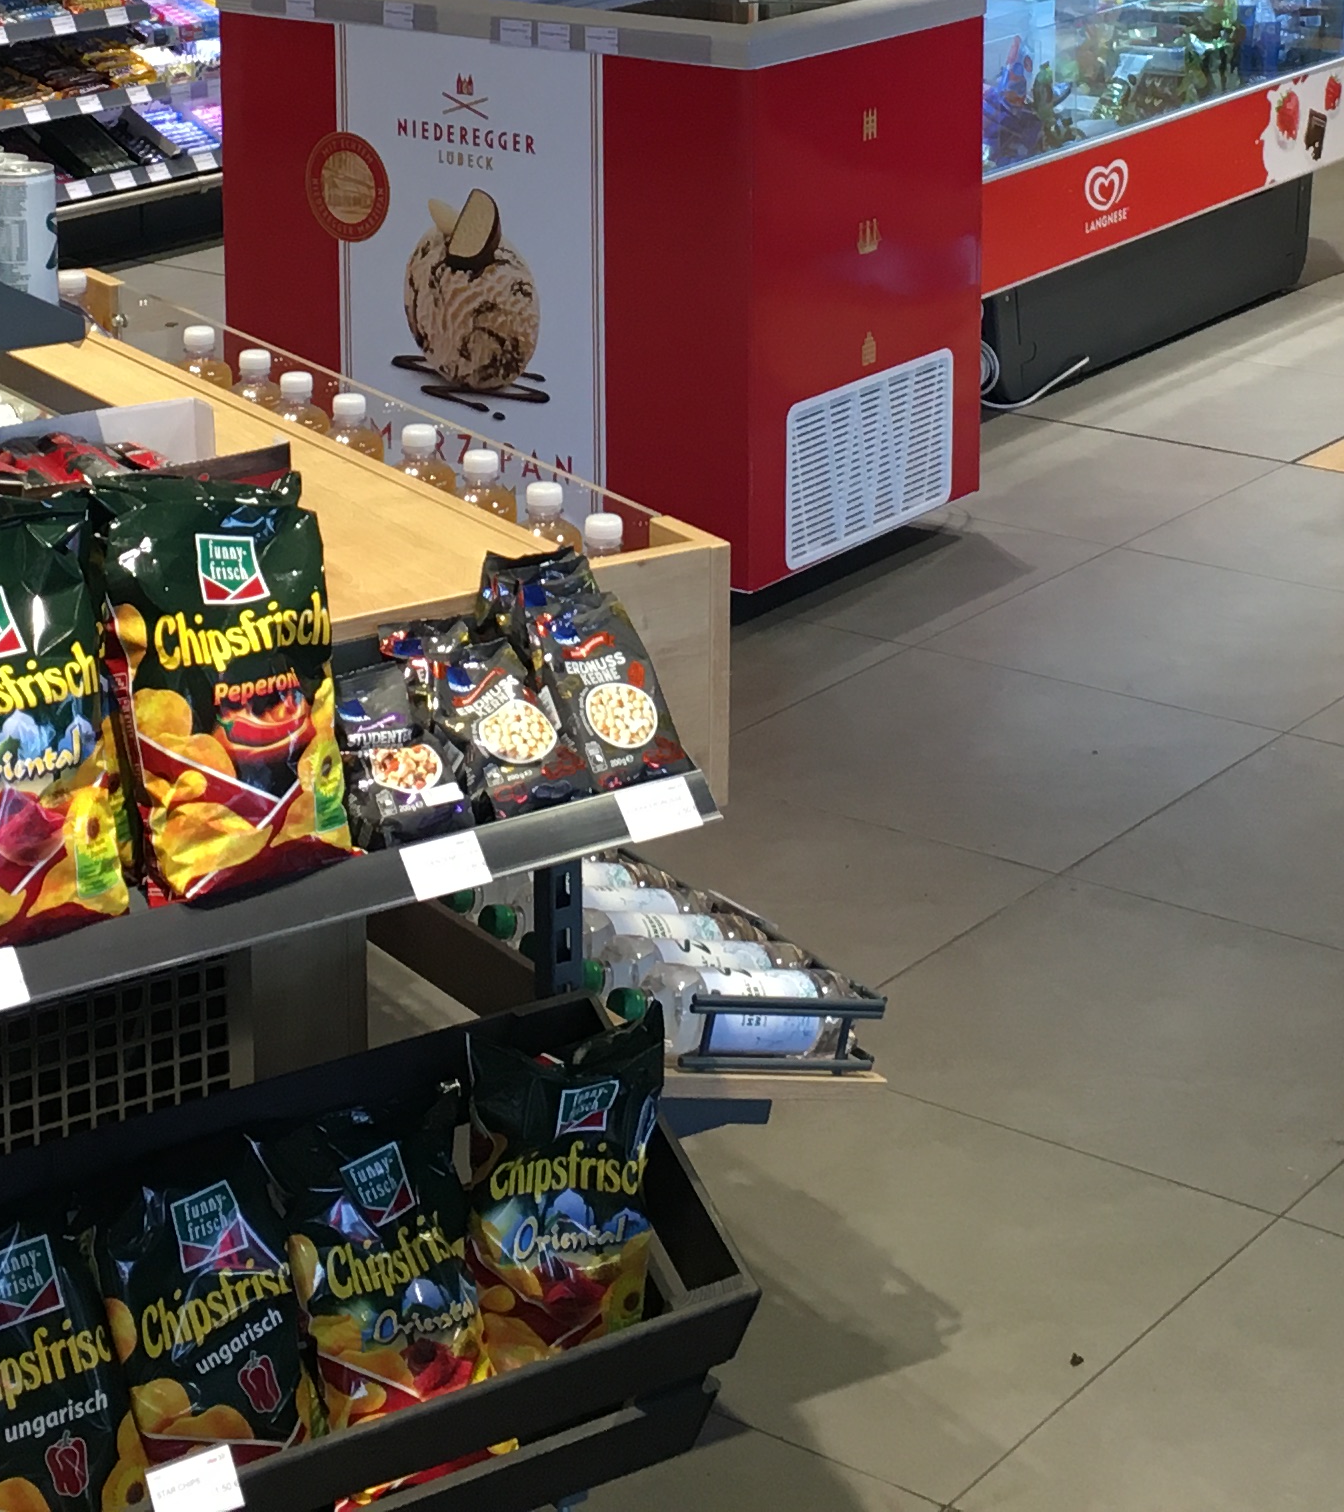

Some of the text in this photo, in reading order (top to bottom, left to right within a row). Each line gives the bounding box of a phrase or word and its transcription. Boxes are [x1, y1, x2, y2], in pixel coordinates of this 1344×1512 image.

[396, 118, 537, 155] NIEDEREGGER
[438, 149, 494, 171] LÜBECK
[1084, 207, 1128, 234] LANGNESE
[369, 418, 574, 486] MRZIPAN
[209, 544, 248, 563] funny-
[209, 561, 249, 580] frisch
[154, 592, 331, 673] Chipsfrisch
[564, 652, 626, 676] ERDNUSS
[213, 669, 301, 705] Peperoni
[349, 1156, 394, 1182] funny-
[183, 1192, 228, 1218] funny-
[356, 1177, 398, 1205] frisch
[187, 1212, 229, 1238] frisch
[513, 1215, 629, 1263] Oriental
[326, 1210, 461, 1299] Chipsfris
[141, 1259, 292, 1358] Chipsfrisc
[372, 1299, 477, 1345] Oriental
[194, 1306, 284, 1375] ungarisch
[3, 1390, 110, 1445] ungarisch
